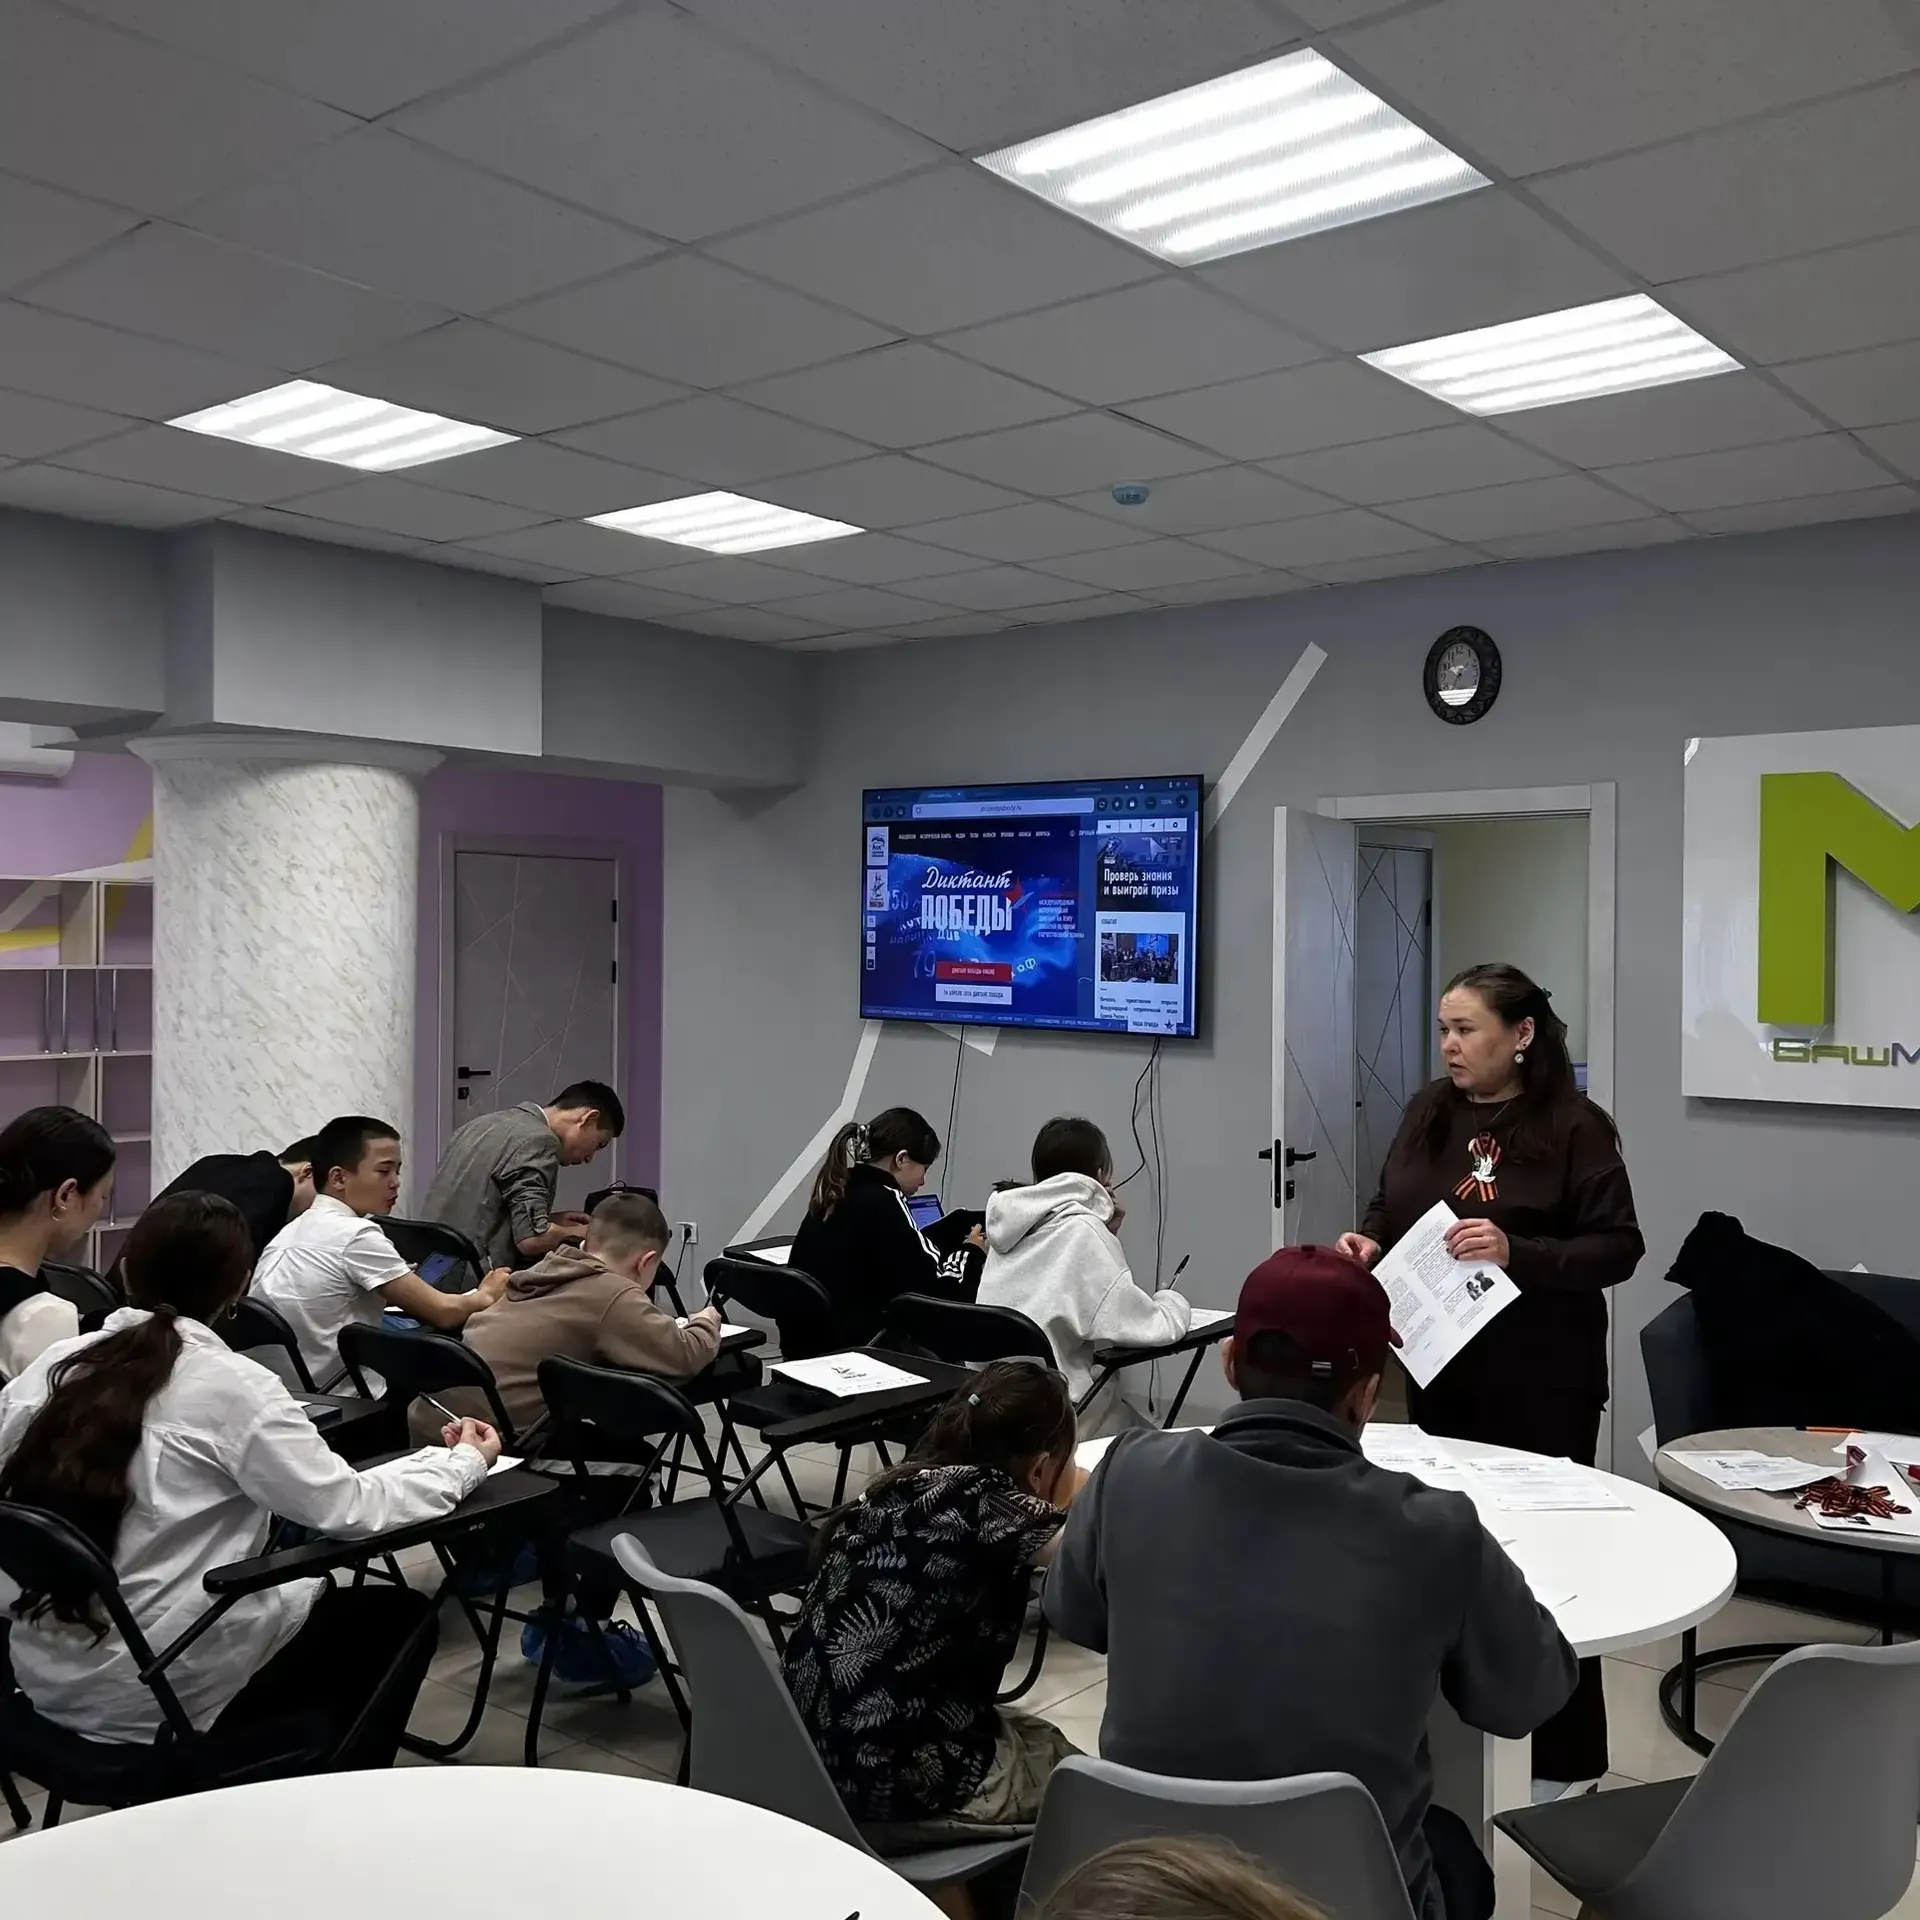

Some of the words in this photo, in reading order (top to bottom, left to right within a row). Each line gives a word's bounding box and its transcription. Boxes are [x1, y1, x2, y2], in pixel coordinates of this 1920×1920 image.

[921, 866, 1013, 889] Диктант
[1104, 868, 1139, 884] Проверь
[1141, 871, 1173, 881] знания
[1103, 886, 1109, 895] и
[1112, 883, 1148, 898] выиграй
[1151, 886, 1179, 898] призы
[921, 895, 1013, 936] ПОБЕДЫ
